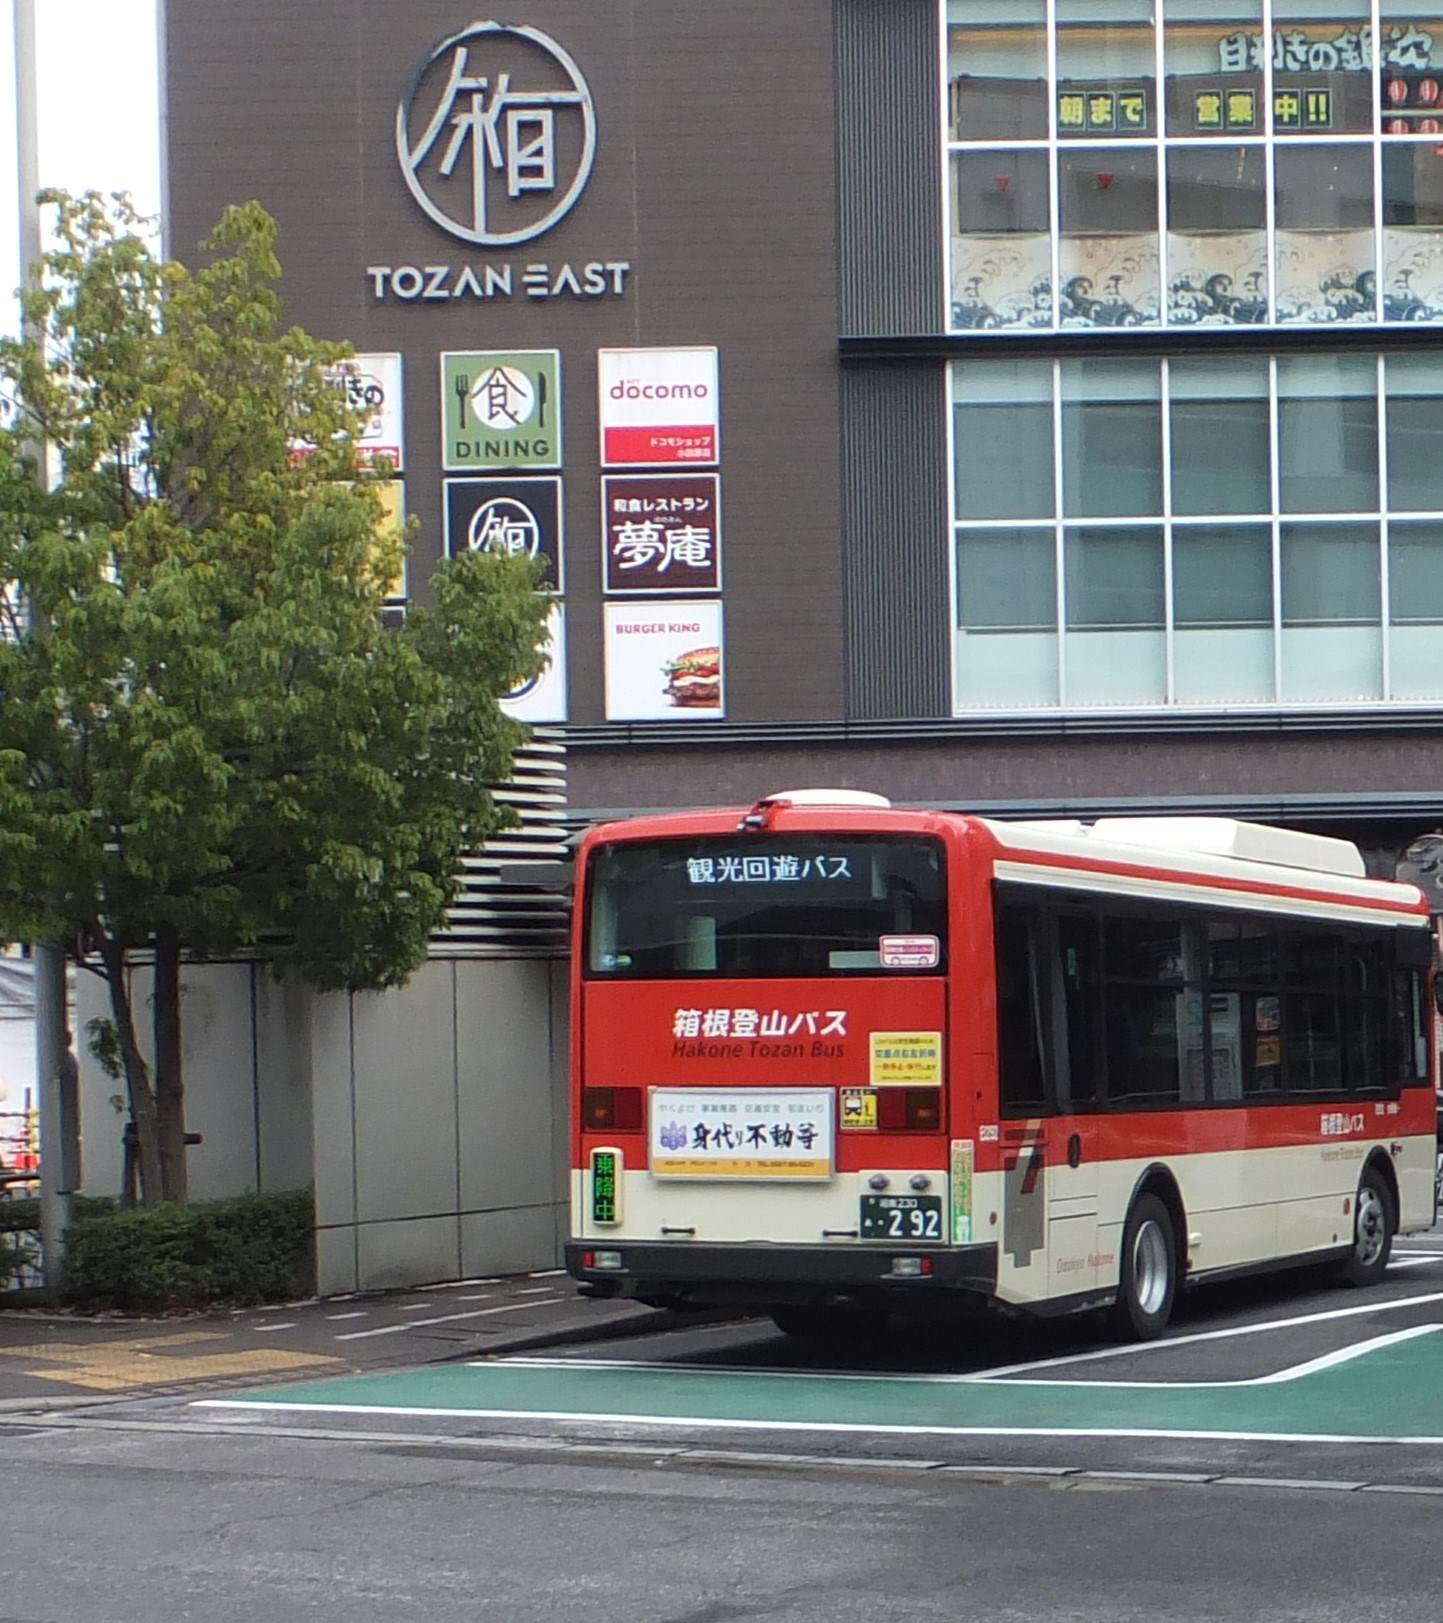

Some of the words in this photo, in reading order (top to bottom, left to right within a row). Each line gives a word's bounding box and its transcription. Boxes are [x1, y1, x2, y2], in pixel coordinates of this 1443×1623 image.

[1058, 96, 1145, 125] 朝まで
[366, 264, 513, 299] TOZAN
[522, 262, 630, 296] EAST
[471, 366, 528, 426] 食
[610, 380, 708, 400] docomo
[456, 439, 549, 459] DINING
[613, 498, 709, 513] 和食レストラン
[612, 519, 712, 572] 夢庵
[615, 624, 666, 634] BURGER
[668, 622, 701, 633] KING
[687, 855, 852, 883] 観光回遊バス
[672, 1008, 848, 1038] 箱根登山バス
[672, 1041, 743, 1058] Hakone
[750, 1041, 804, 1057] Tozan
[810, 1040, 845, 1057] Bus
[595, 1153, 614, 1221] 乗降中
